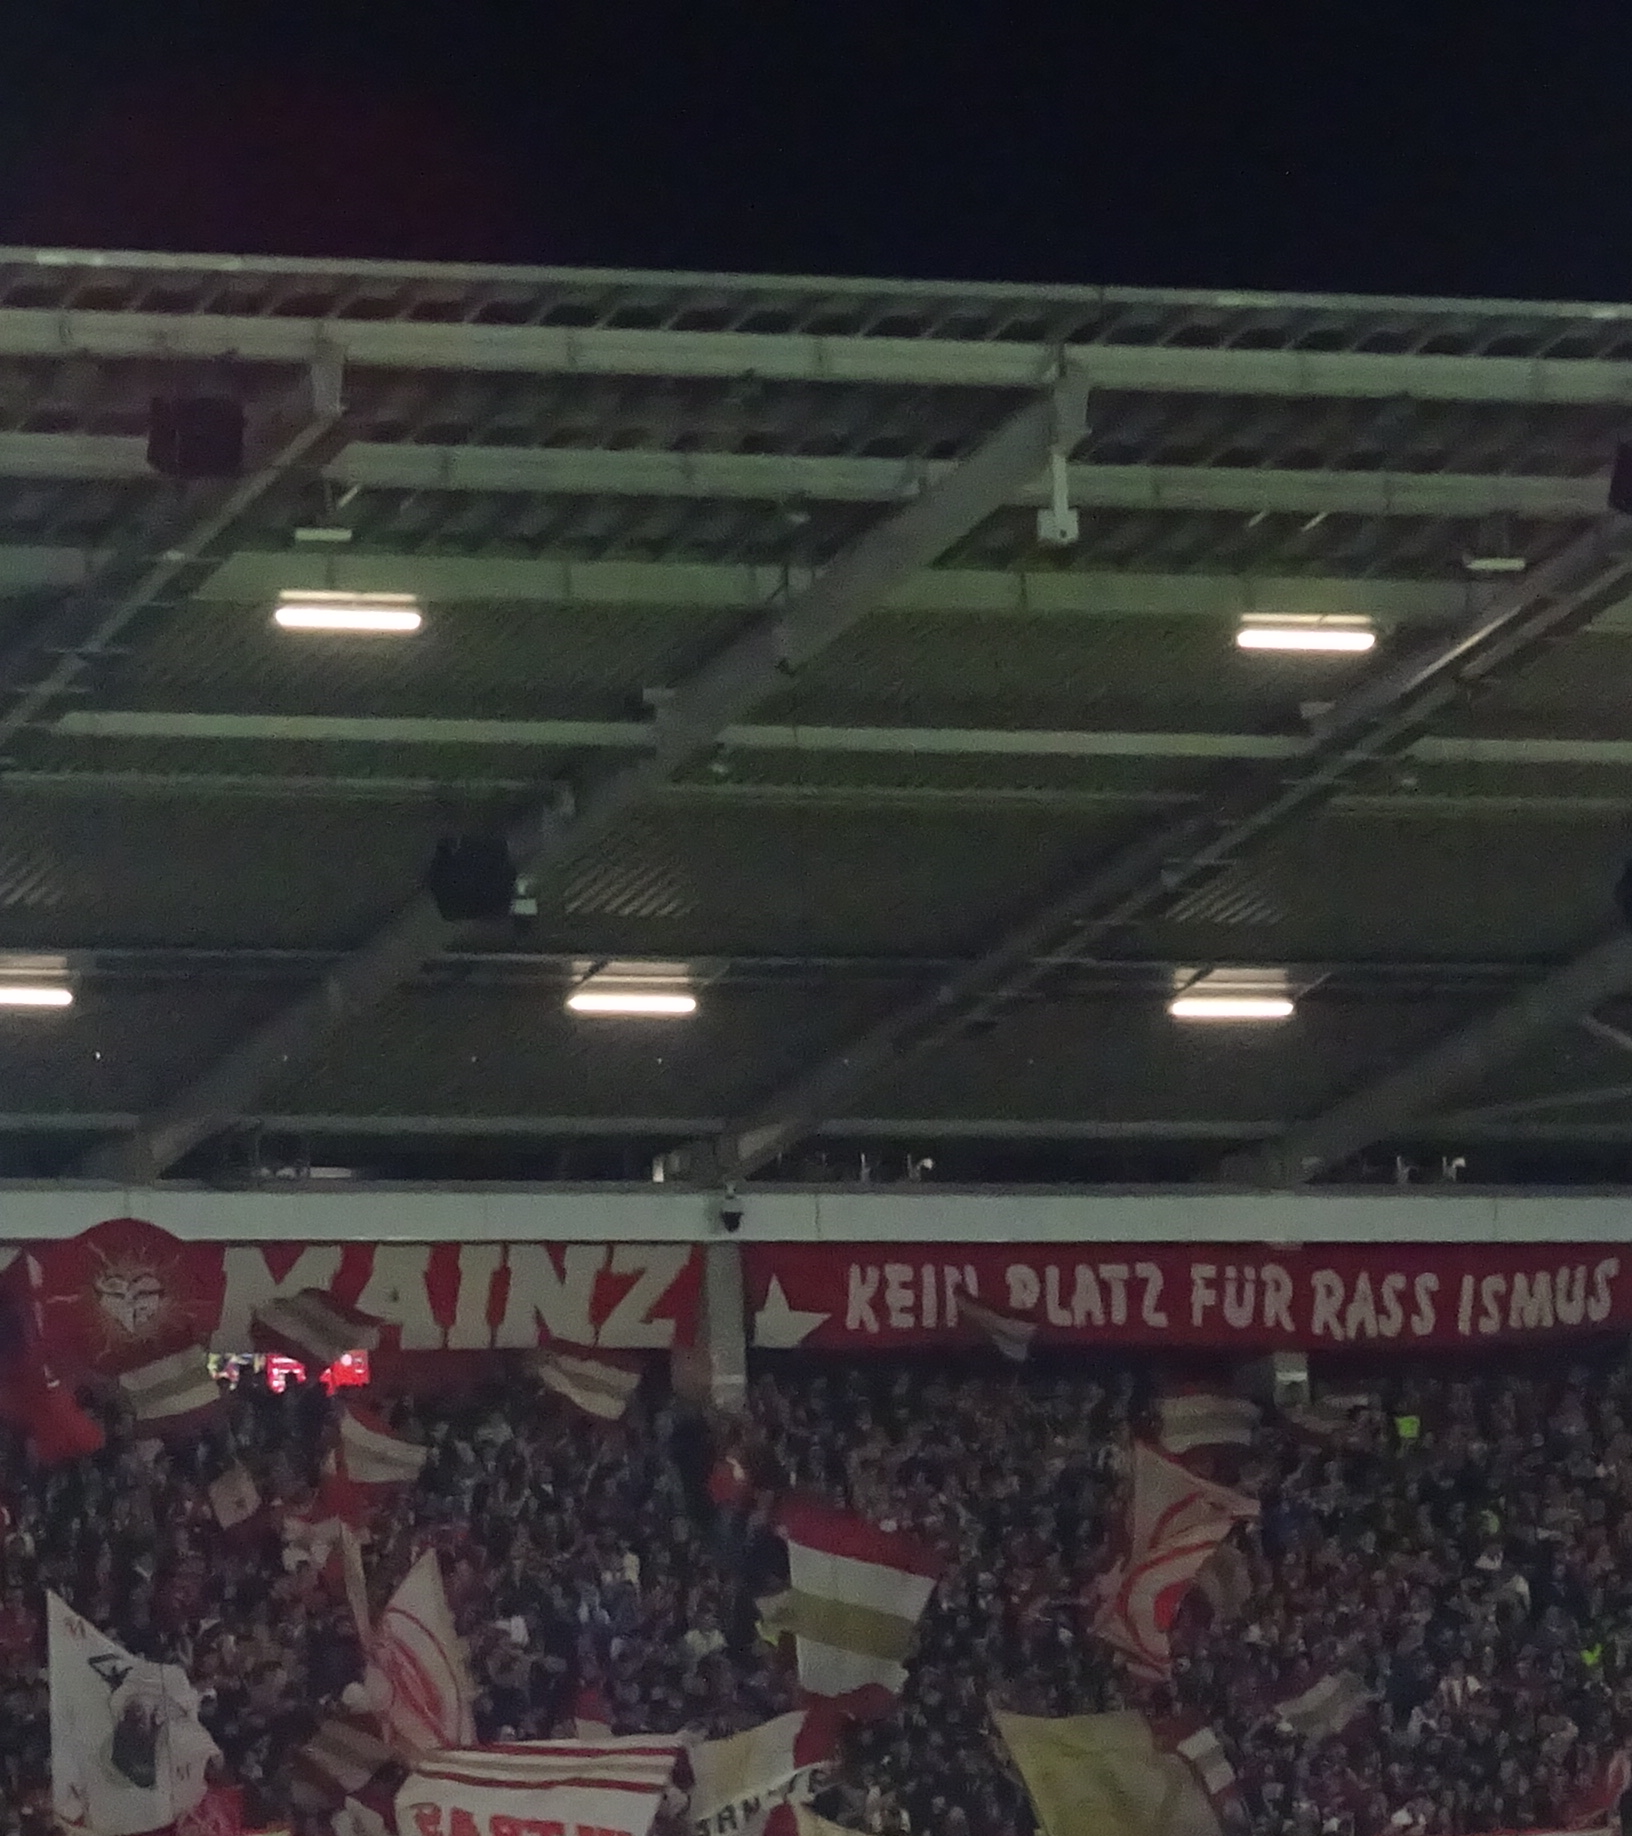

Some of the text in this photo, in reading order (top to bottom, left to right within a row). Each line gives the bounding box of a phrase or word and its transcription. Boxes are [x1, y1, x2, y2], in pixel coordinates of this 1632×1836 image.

[216, 1244, 682, 1350] MAINZ
[845, 1257, 1622, 1341] KEIN PLATZ FÜR RASS ISMUS
